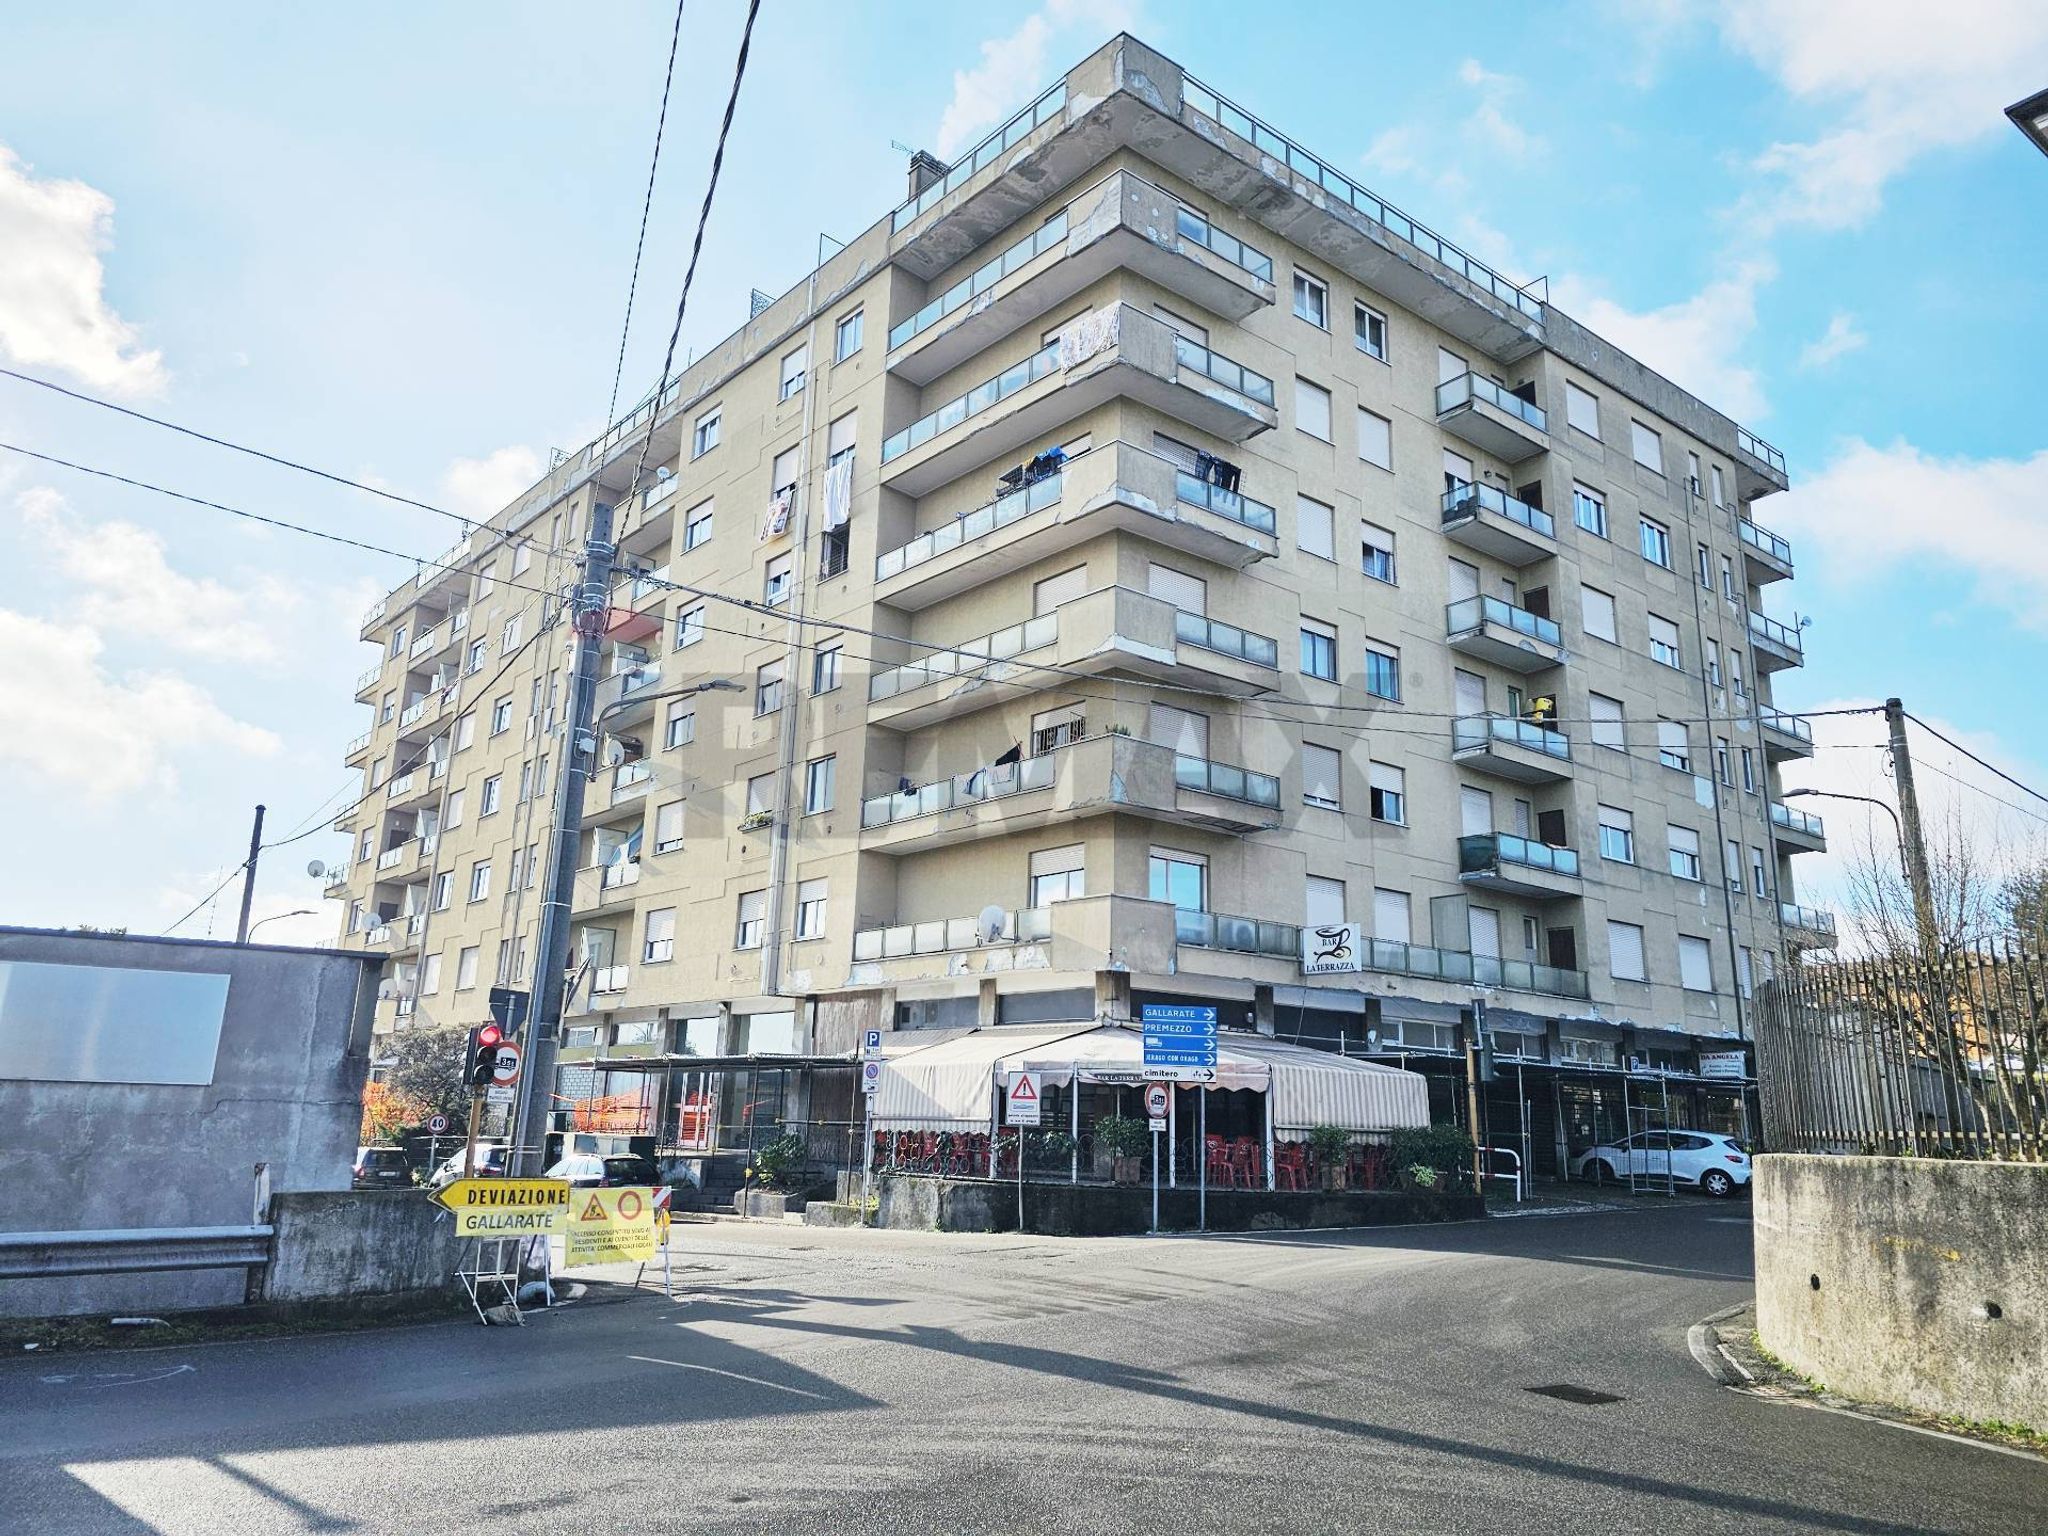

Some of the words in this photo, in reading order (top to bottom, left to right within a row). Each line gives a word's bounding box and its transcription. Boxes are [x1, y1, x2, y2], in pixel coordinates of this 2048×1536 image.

[1322, 938, 1337, 946] BAR
[1306, 964, 1315, 973] LA
[1316, 962, 1355, 972] TERRAZZA
[1145, 1008, 1196, 1018] GALLARATE
[1144, 1023, 1192, 1033] PREMEZZO
[869, 1032, 878, 1046] P
[1144, 1069, 1179, 1078] cimitero
[432, 1118, 444, 1129] 40
[467, 1189, 566, 1204] DEVIAZIONE
[466, 1214, 553, 1230] GALLARATE
